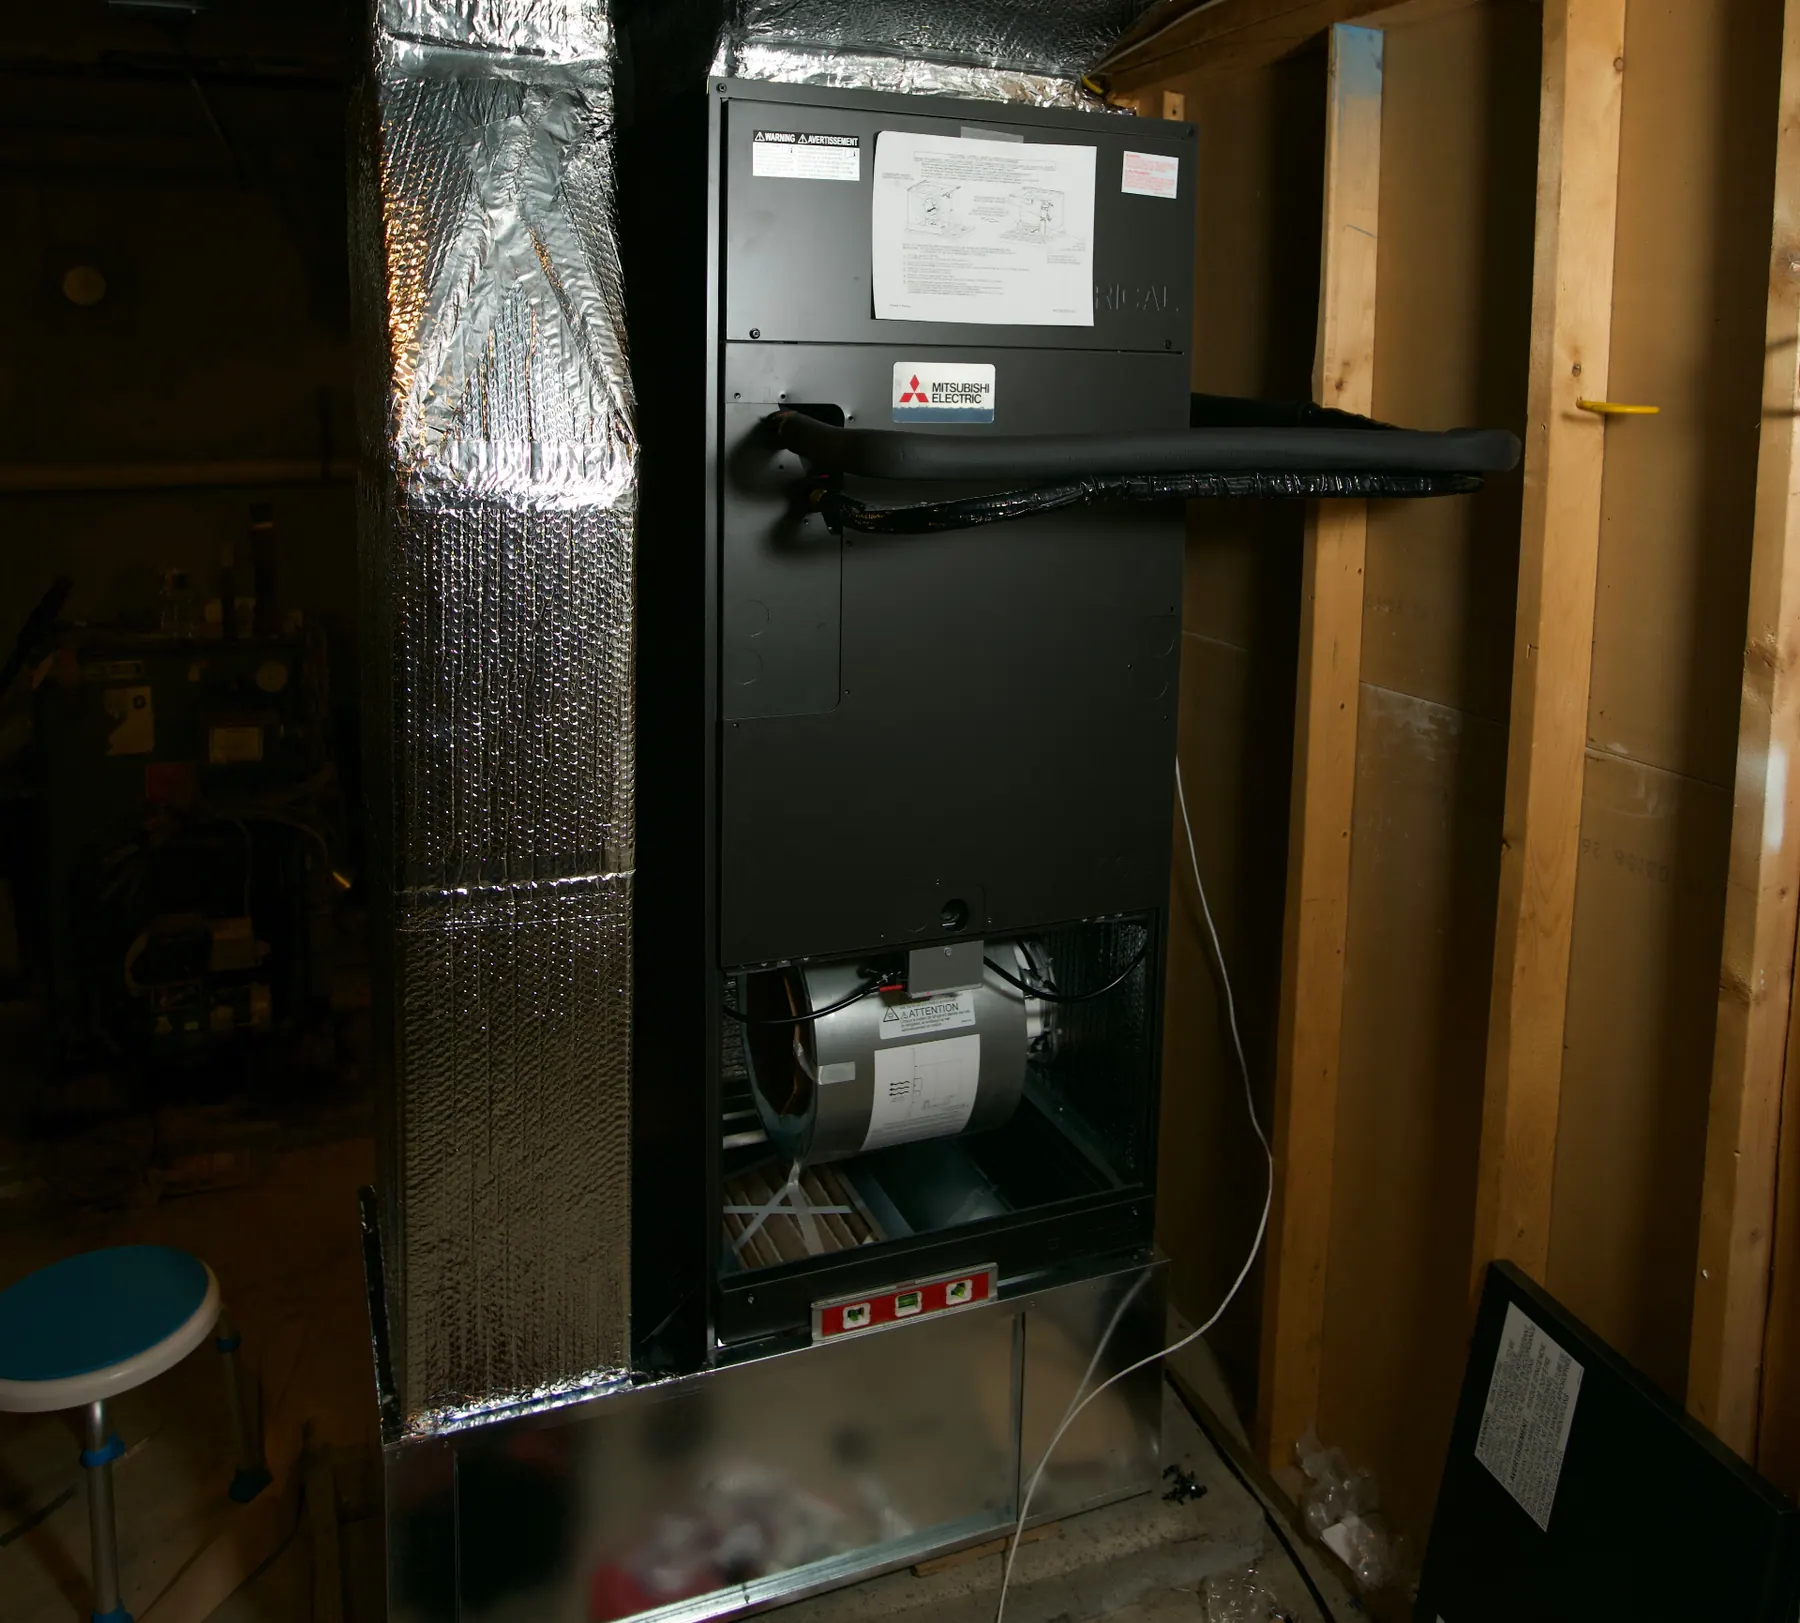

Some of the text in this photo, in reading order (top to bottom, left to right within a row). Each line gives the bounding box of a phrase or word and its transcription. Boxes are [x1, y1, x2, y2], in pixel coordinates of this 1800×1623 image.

[764, 132, 796, 143] WARNING
[808, 135, 858, 146] AVERTISSEMENT
[932, 382, 990, 393] MITSUBISHI
[932, 393, 982, 404] ELECTRIC
[908, 1003, 959, 1018] ATTENTION
[1510, 1418, 1527, 1482] AVERTISSEMENT
